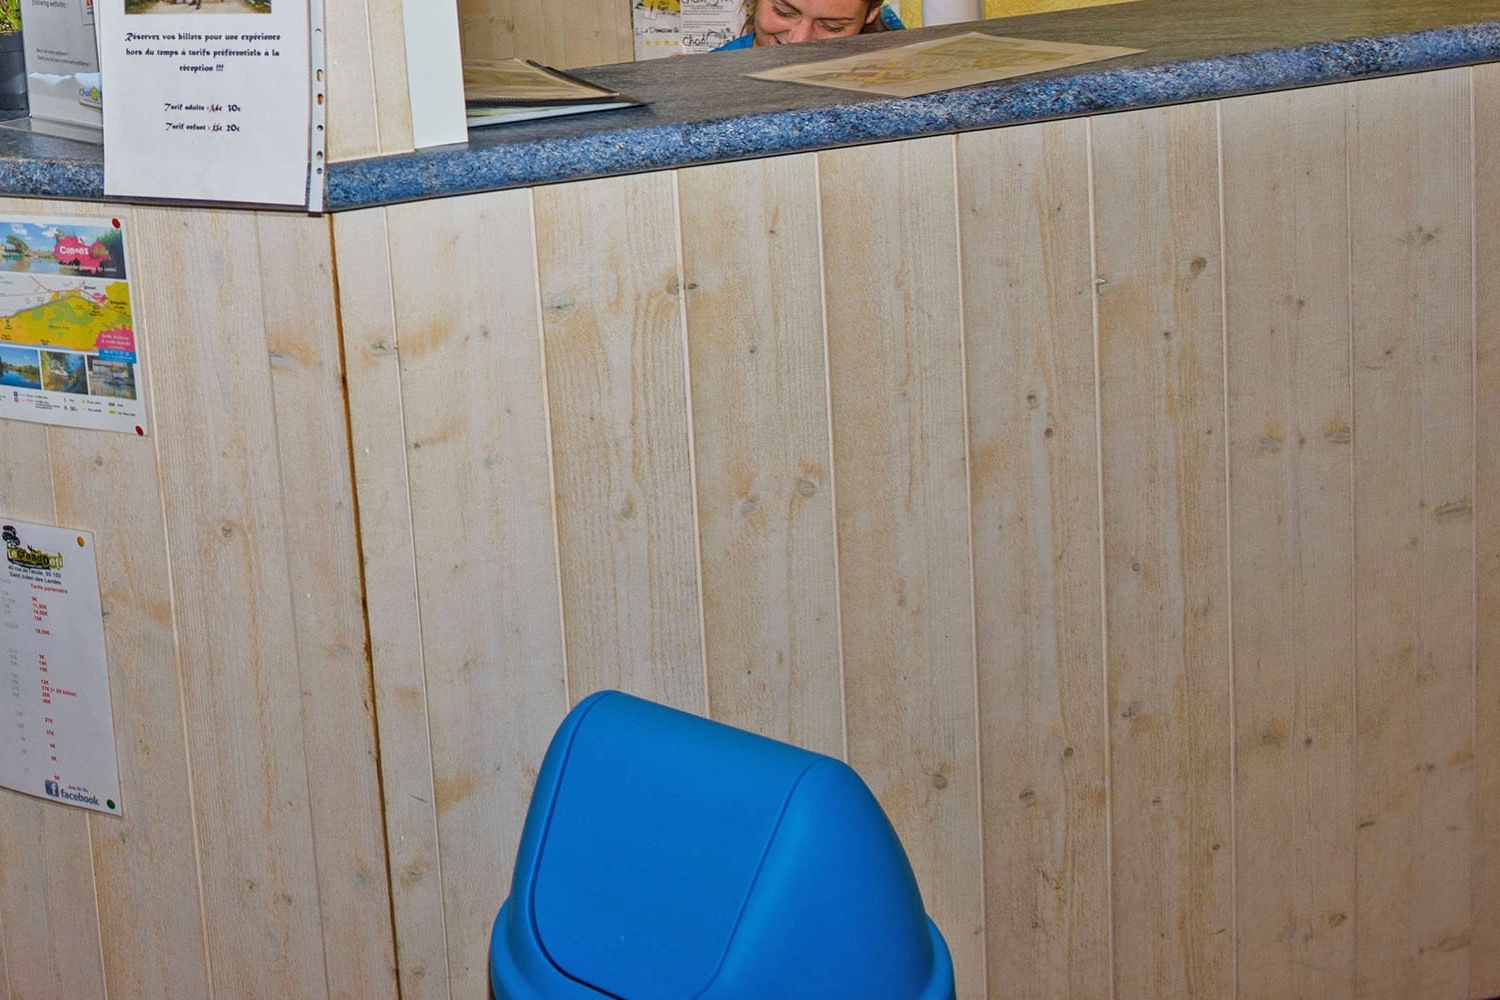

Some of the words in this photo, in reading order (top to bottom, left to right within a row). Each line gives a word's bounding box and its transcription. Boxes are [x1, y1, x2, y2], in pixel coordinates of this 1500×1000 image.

[241, 33, 280, 42] expérience
[157, 50, 178, 58] temps
[213, 49, 260, 58] préférentiels
[180, 64, 213, 73] réception
[61, 789, 99, 805] facebook
